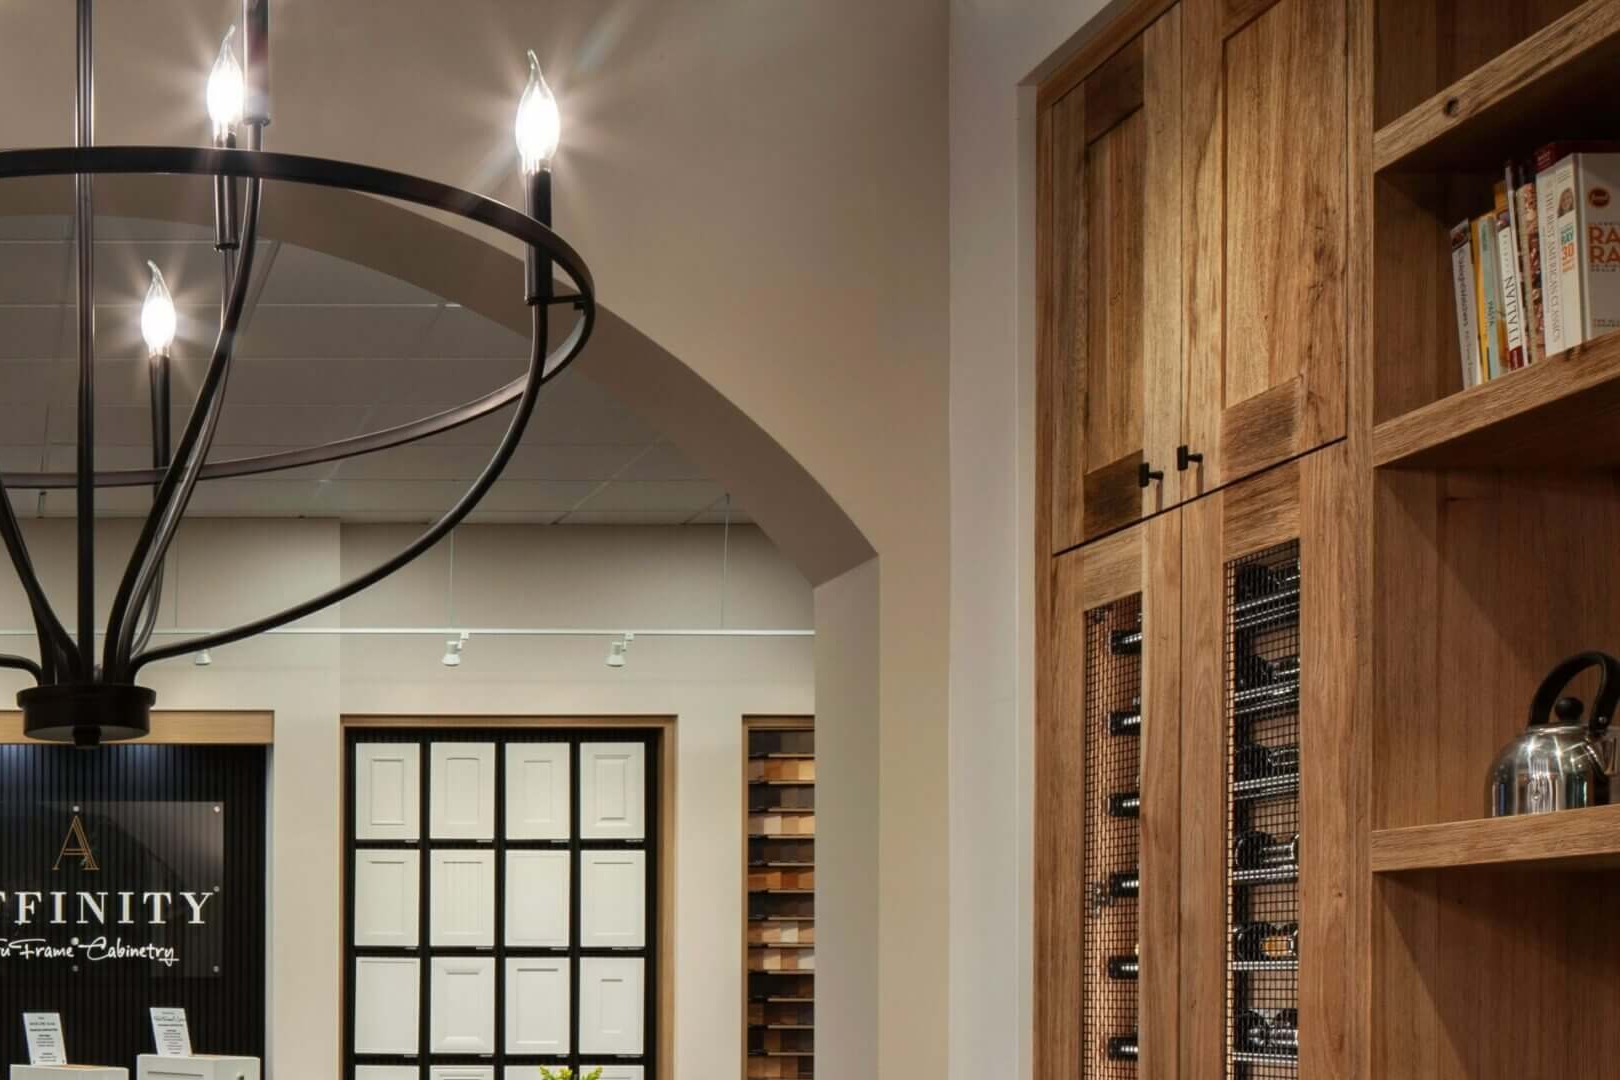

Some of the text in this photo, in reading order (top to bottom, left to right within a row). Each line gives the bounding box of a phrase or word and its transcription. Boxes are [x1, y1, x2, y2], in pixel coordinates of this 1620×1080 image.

[1504, 276, 1519, 343] ITALIAN
[52, 815, 100, 870] A
[79, 936, 180, 966] Cabinetry
